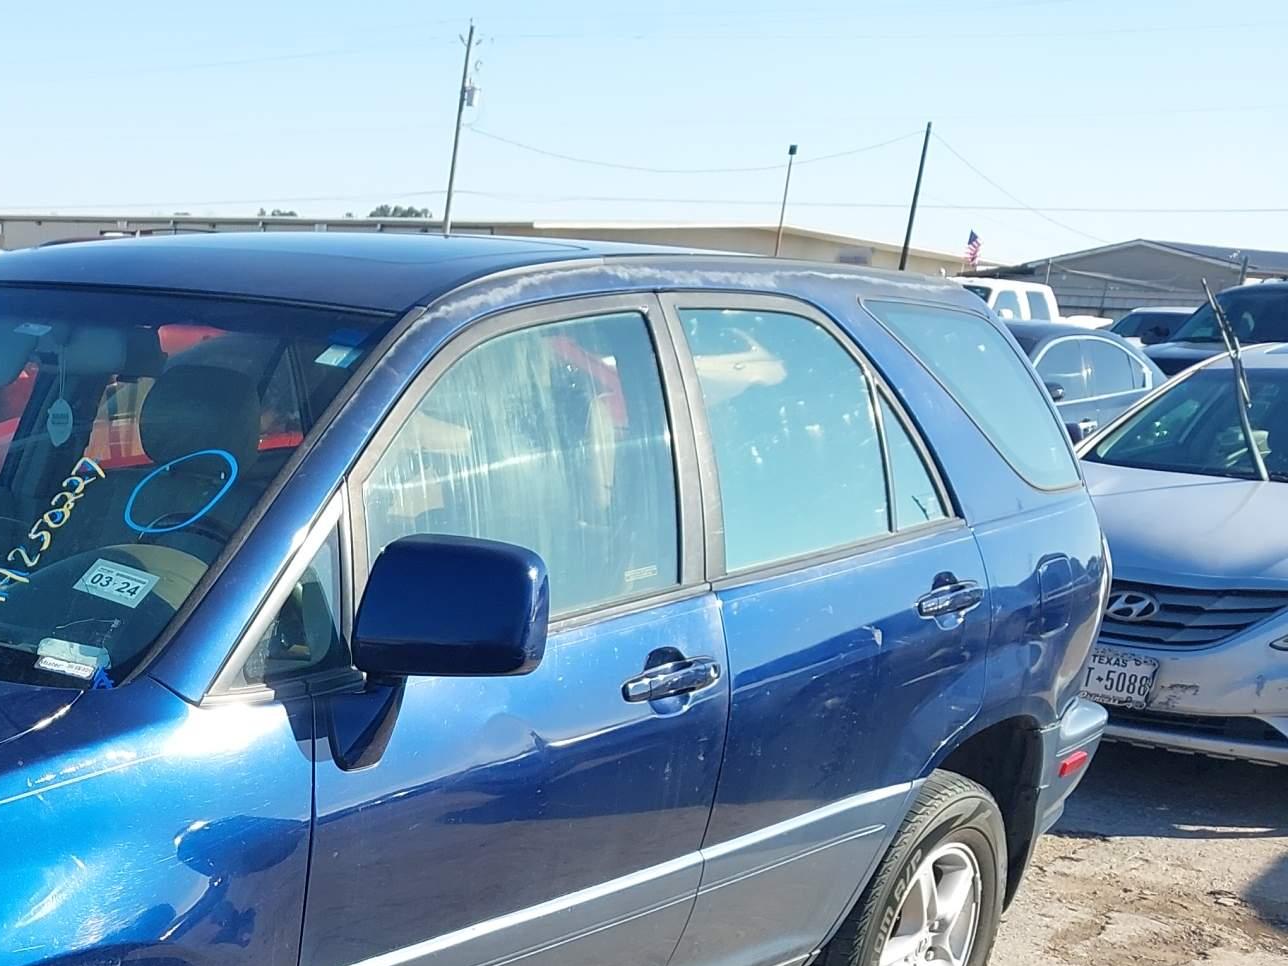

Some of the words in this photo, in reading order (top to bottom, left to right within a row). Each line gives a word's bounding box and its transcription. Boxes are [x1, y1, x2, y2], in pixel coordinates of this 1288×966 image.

[90, 573, 113, 588] 03
[114, 581, 141, 597] 24
[1091, 654, 1128, 668] TEXAS
